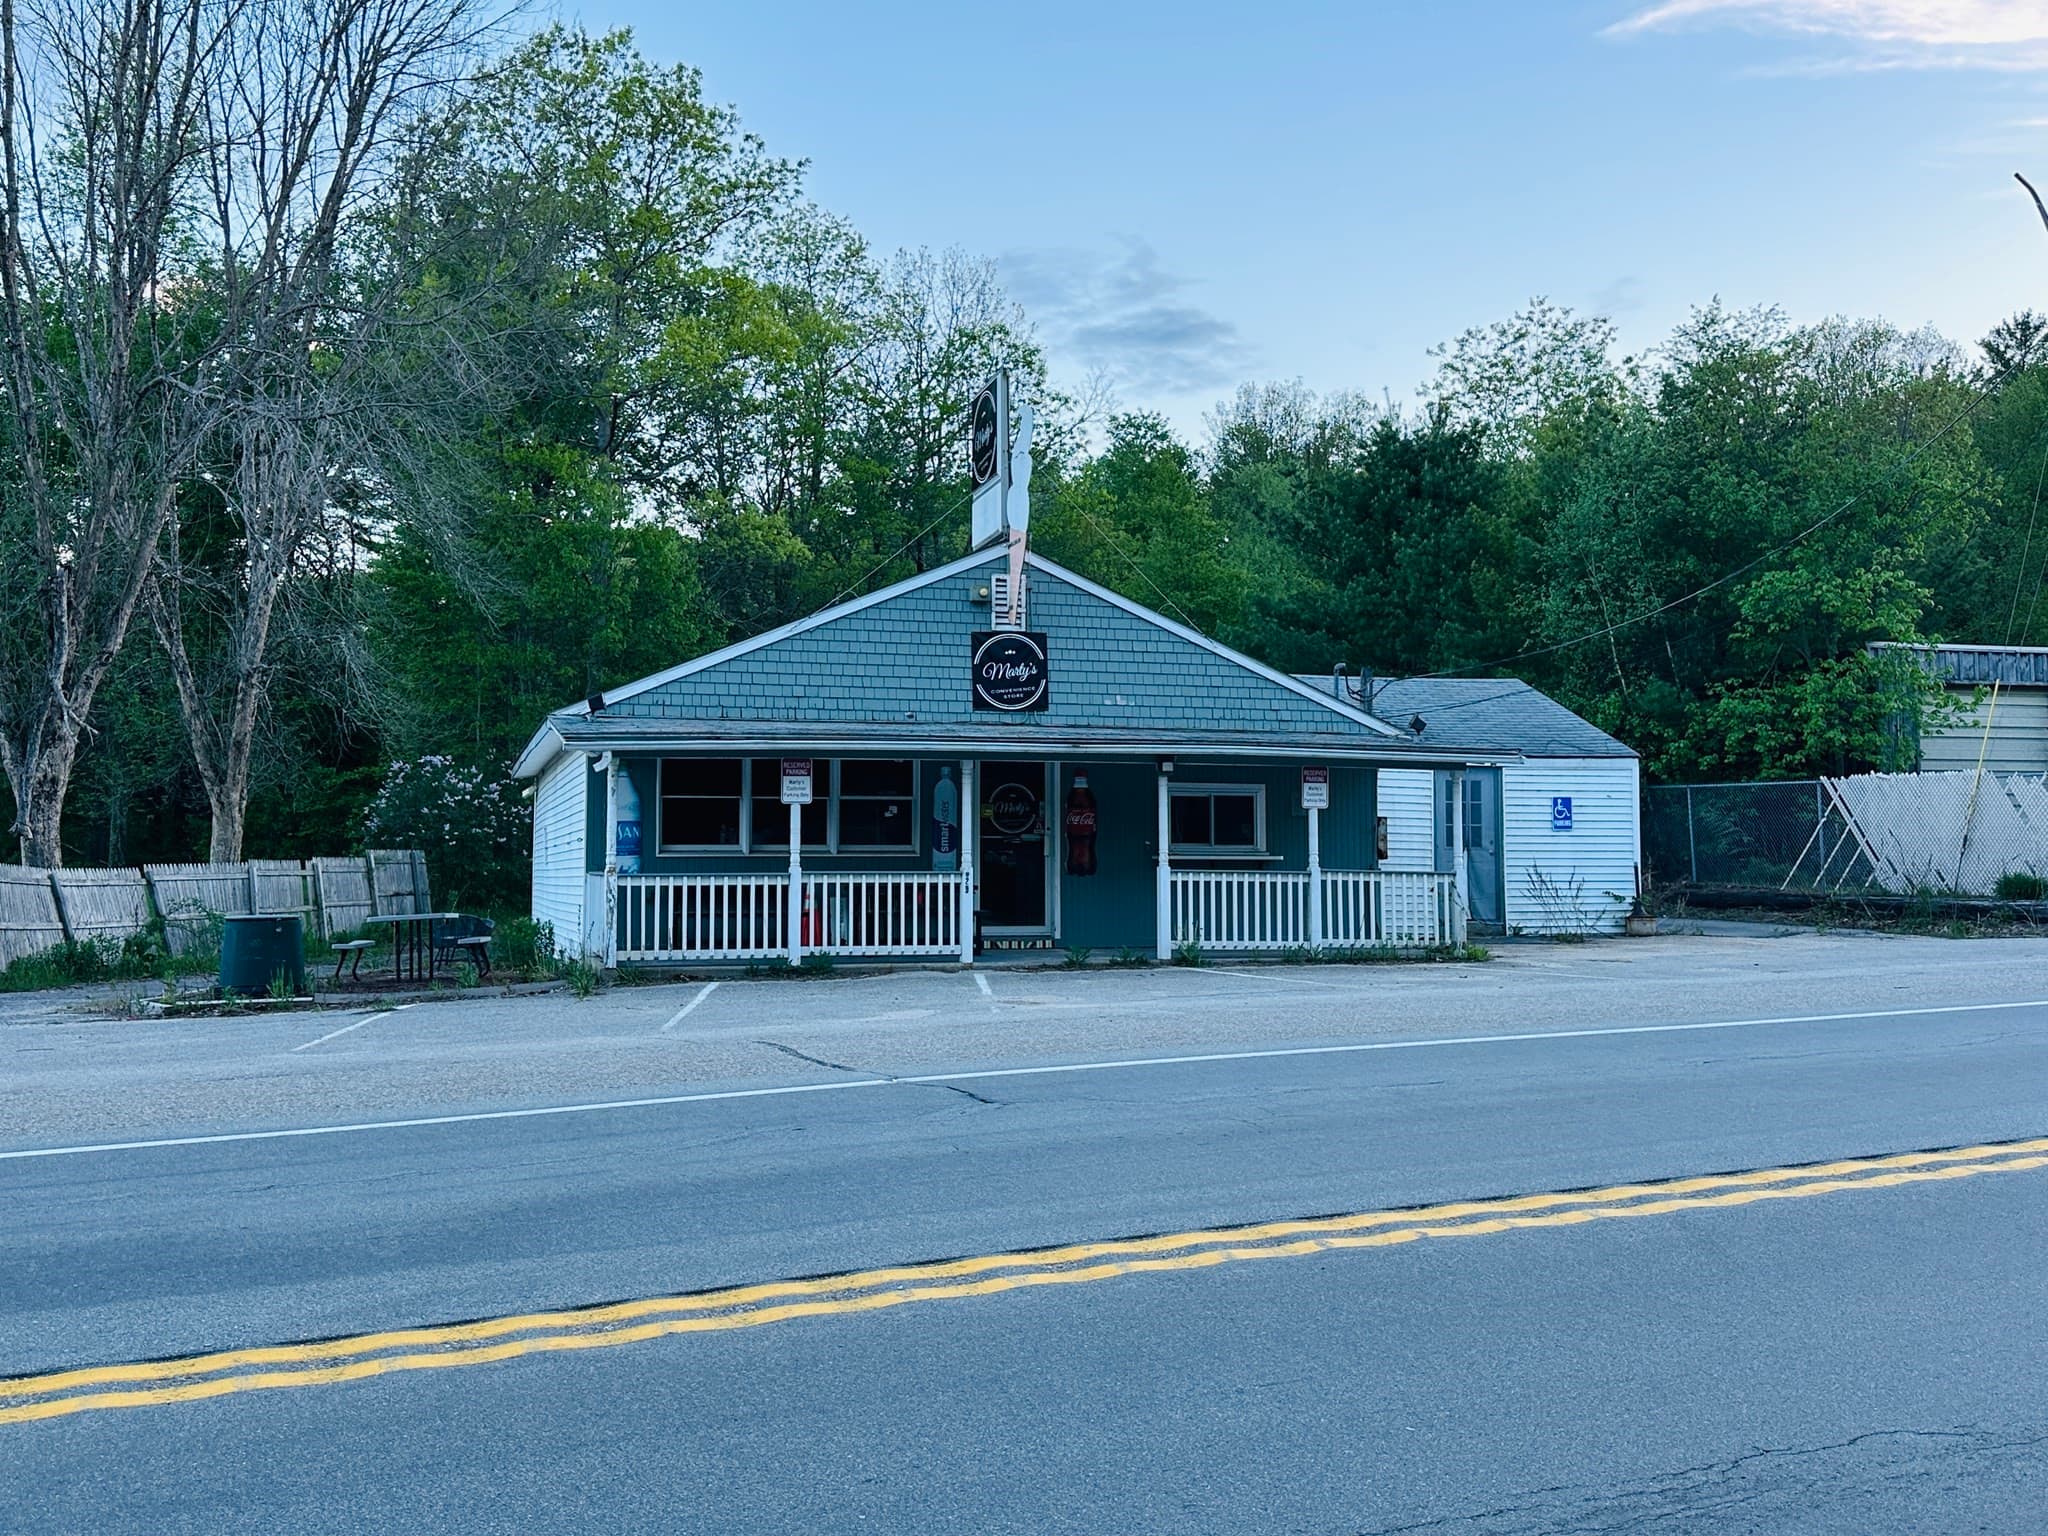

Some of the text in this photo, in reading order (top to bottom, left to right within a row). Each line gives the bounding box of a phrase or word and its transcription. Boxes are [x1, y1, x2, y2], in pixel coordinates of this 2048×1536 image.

[983, 662, 1038, 682] Marty's
[990, 686, 1036, 695] CONVENIENCE
[783, 761, 811, 769] RESERVED
[785, 768, 808, 776] PARKING
